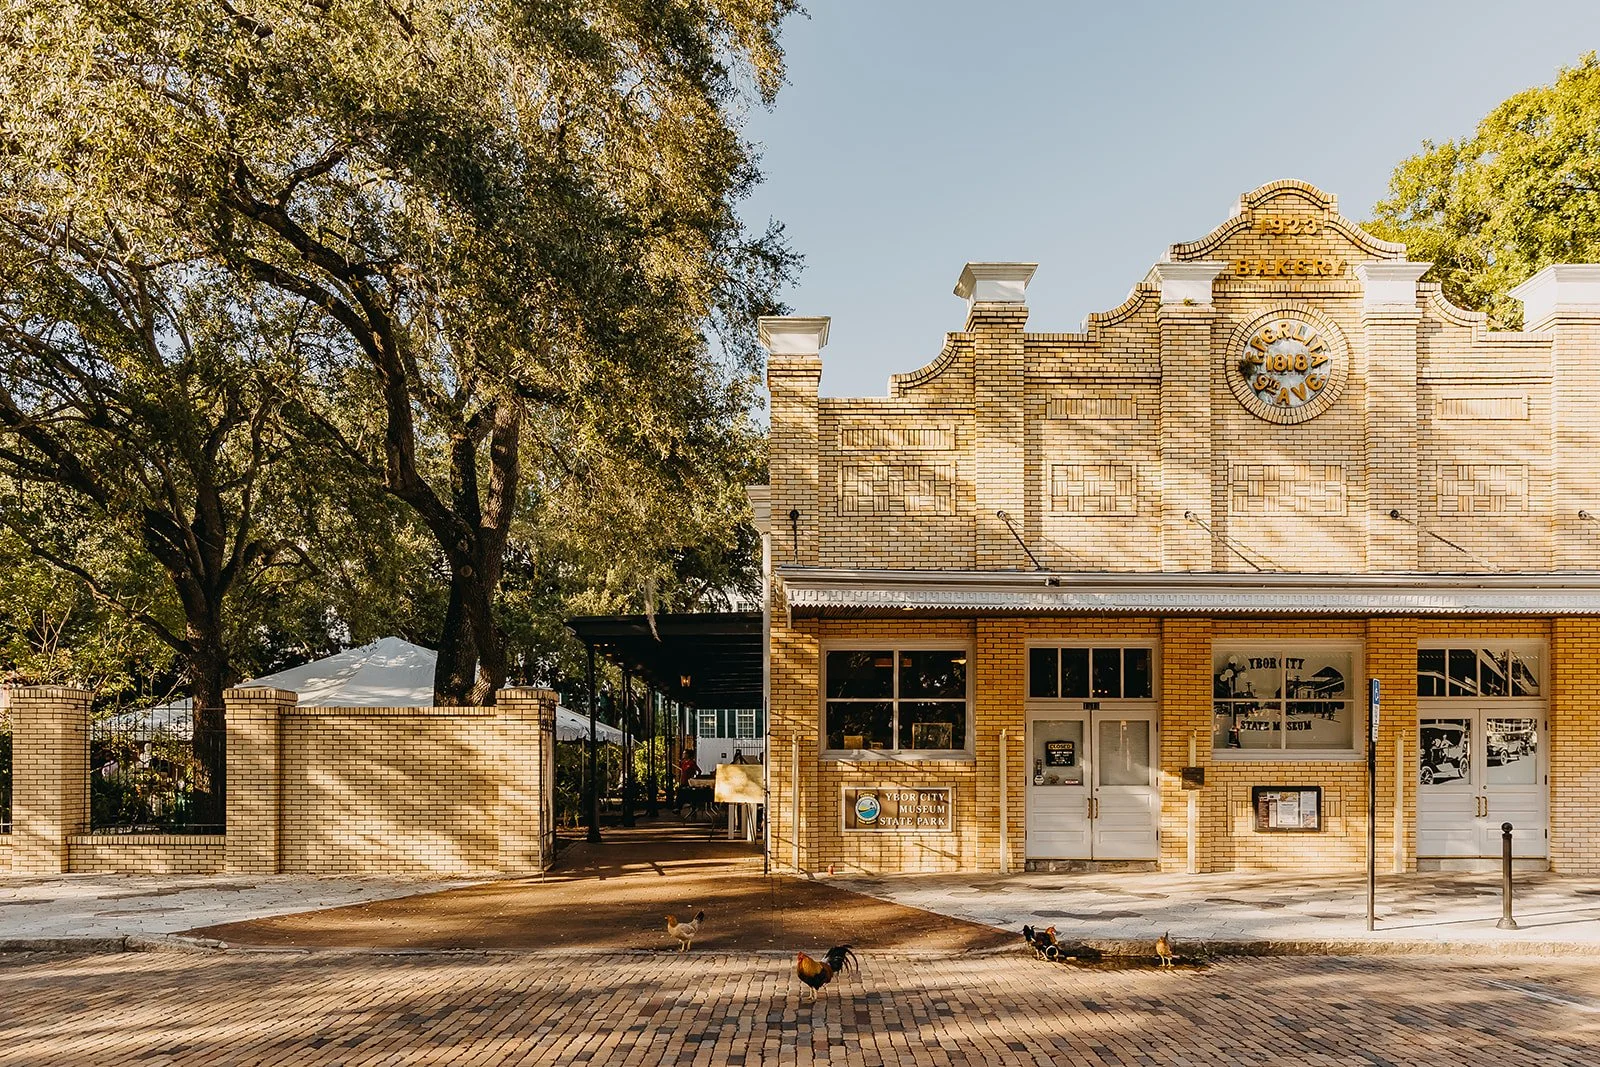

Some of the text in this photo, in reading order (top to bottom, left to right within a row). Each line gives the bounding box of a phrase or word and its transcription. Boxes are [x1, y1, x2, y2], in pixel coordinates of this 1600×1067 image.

[1260, 217, 1318, 235] 1923
[1236, 258, 1345, 276] BAKERY
[1250, 321, 1329, 368] FERLITA
[1266, 354, 1308, 372] 1818
[1248, 657, 1277, 669] YBOR
[1240, 720, 1312, 731] STATE MSEUM
[885, 792, 945, 802] YBOR CITY
[899, 805, 945, 814] MUSEUM
[880, 817, 913, 826] STATE
[917, 817, 945, 826] PARK
